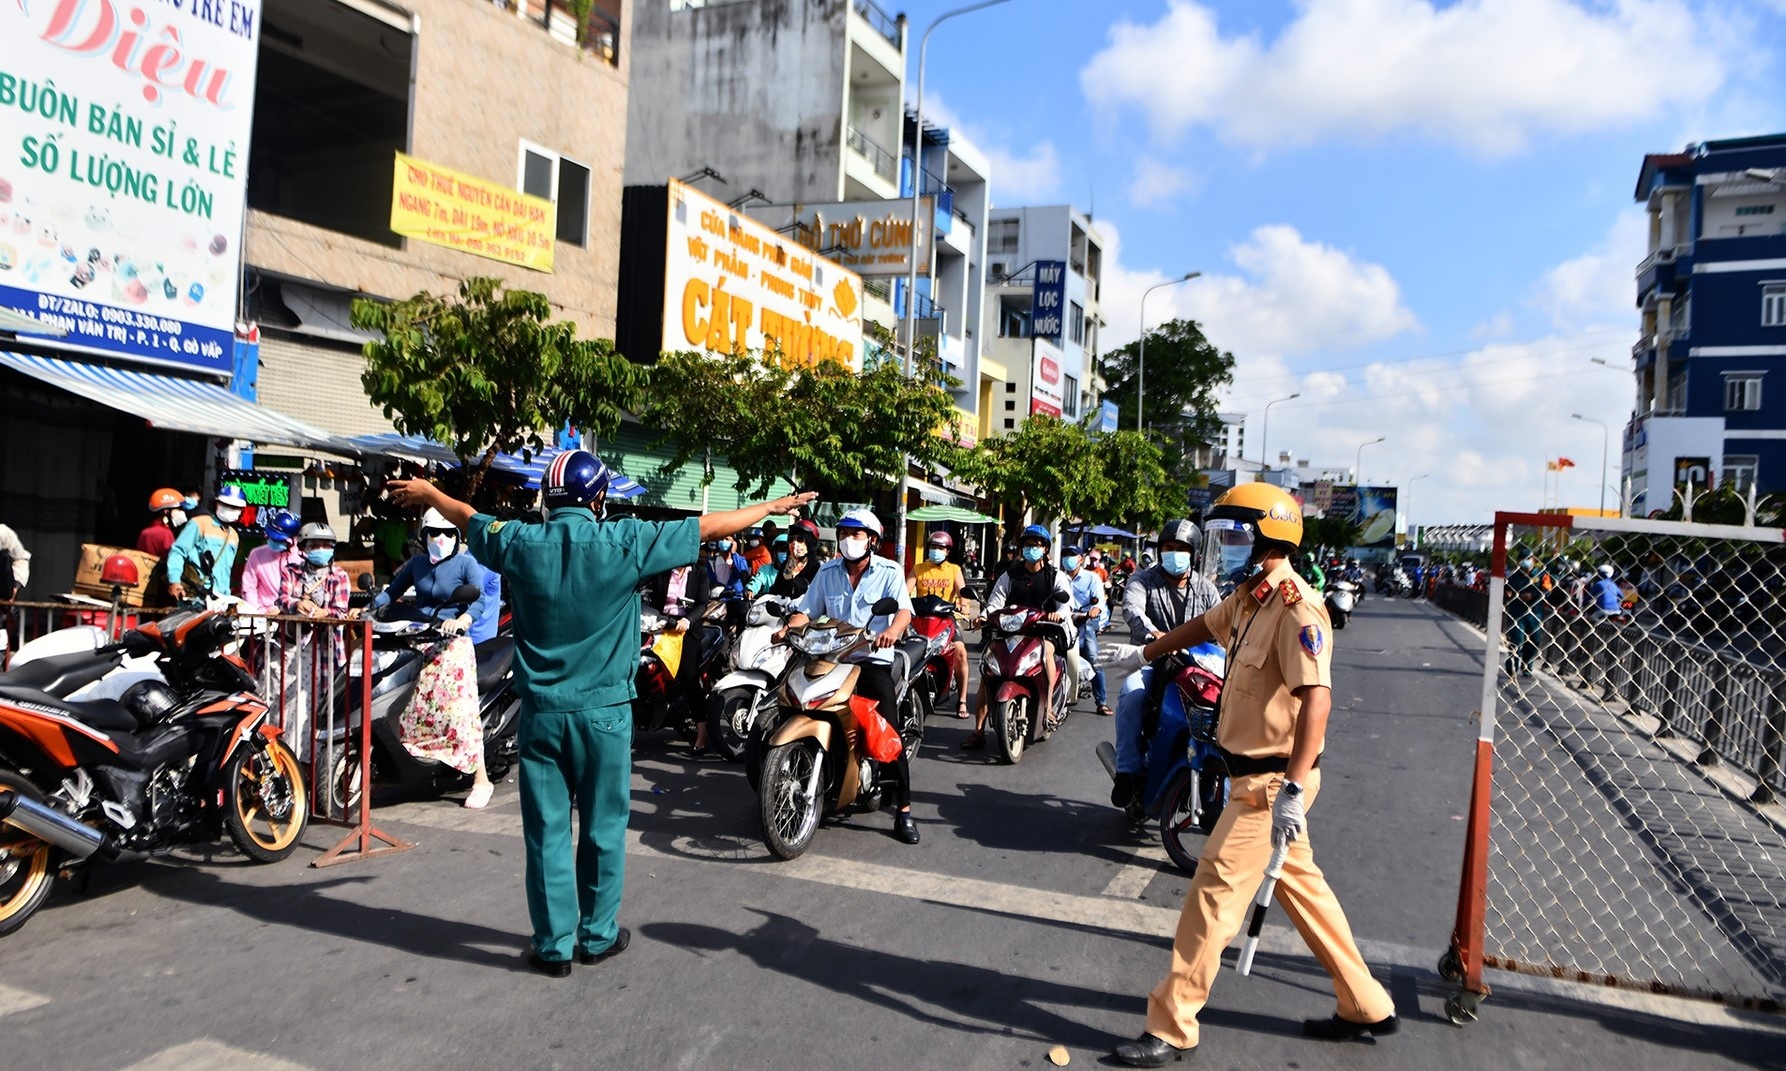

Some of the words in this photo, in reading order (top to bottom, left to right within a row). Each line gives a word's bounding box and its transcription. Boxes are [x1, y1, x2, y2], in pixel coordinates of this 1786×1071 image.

[229, 1, 254, 40] EM
[40, 0, 233, 106] Diệu
[0, 71, 78, 127] BUÔN
[88, 102, 143, 149] BÁN
[151, 118, 178, 158] SỈ
[182, 137, 200, 168] &
[209, 140, 238, 180] LẺ
[20, 132, 63, 173] SỐ
[70, 150, 158, 203] LƯỢNG
[166, 177, 214, 220] LỚN
[701, 209, 725, 239] CỬA
[729, 221, 760, 256] HÀNG
[829, 213, 867, 249] THỜ
[1039, 264, 1062, 285] MÁY
[682, 276, 753, 358] CÁT
[1038, 291, 1059, 311] LỌC
[1034, 313, 1061, 335] NƯỚC
